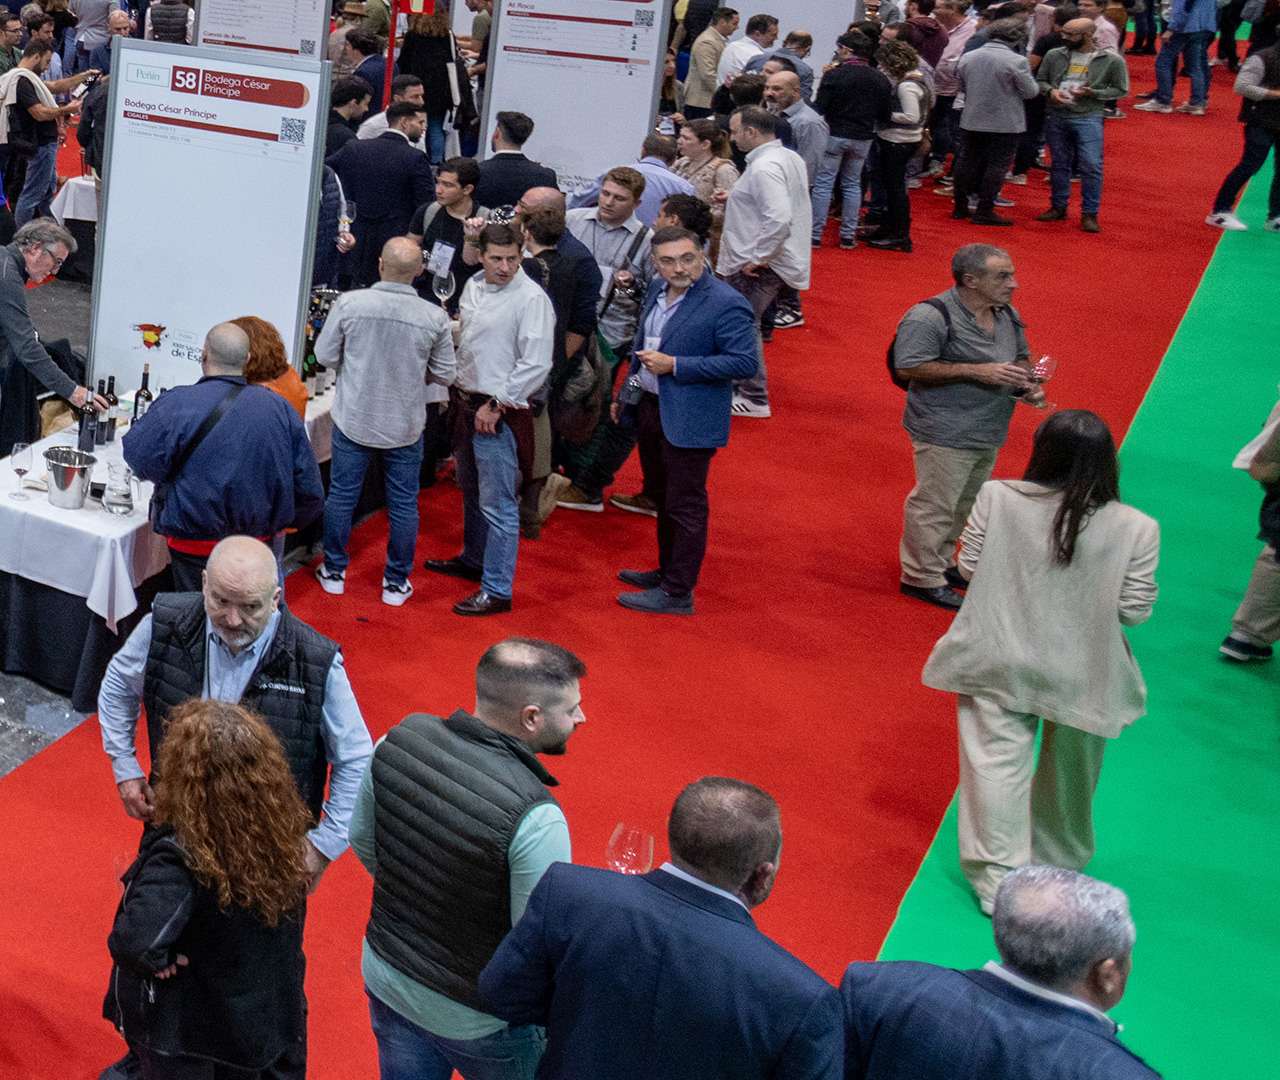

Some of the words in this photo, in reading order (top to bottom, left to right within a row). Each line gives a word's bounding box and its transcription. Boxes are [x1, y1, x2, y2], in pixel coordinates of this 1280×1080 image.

[136, 68, 160, 81] Peñín
[175, 71, 197, 89] 58
[204, 74, 241, 88] Bodega
[243, 78, 271, 91] César
[204, 83, 241, 98] Príncipe
[124, 98, 157, 111] Bodega
[158, 103, 182, 115] César
[184, 106, 217, 120] Príncipe
[171, 349, 185, 358] de
